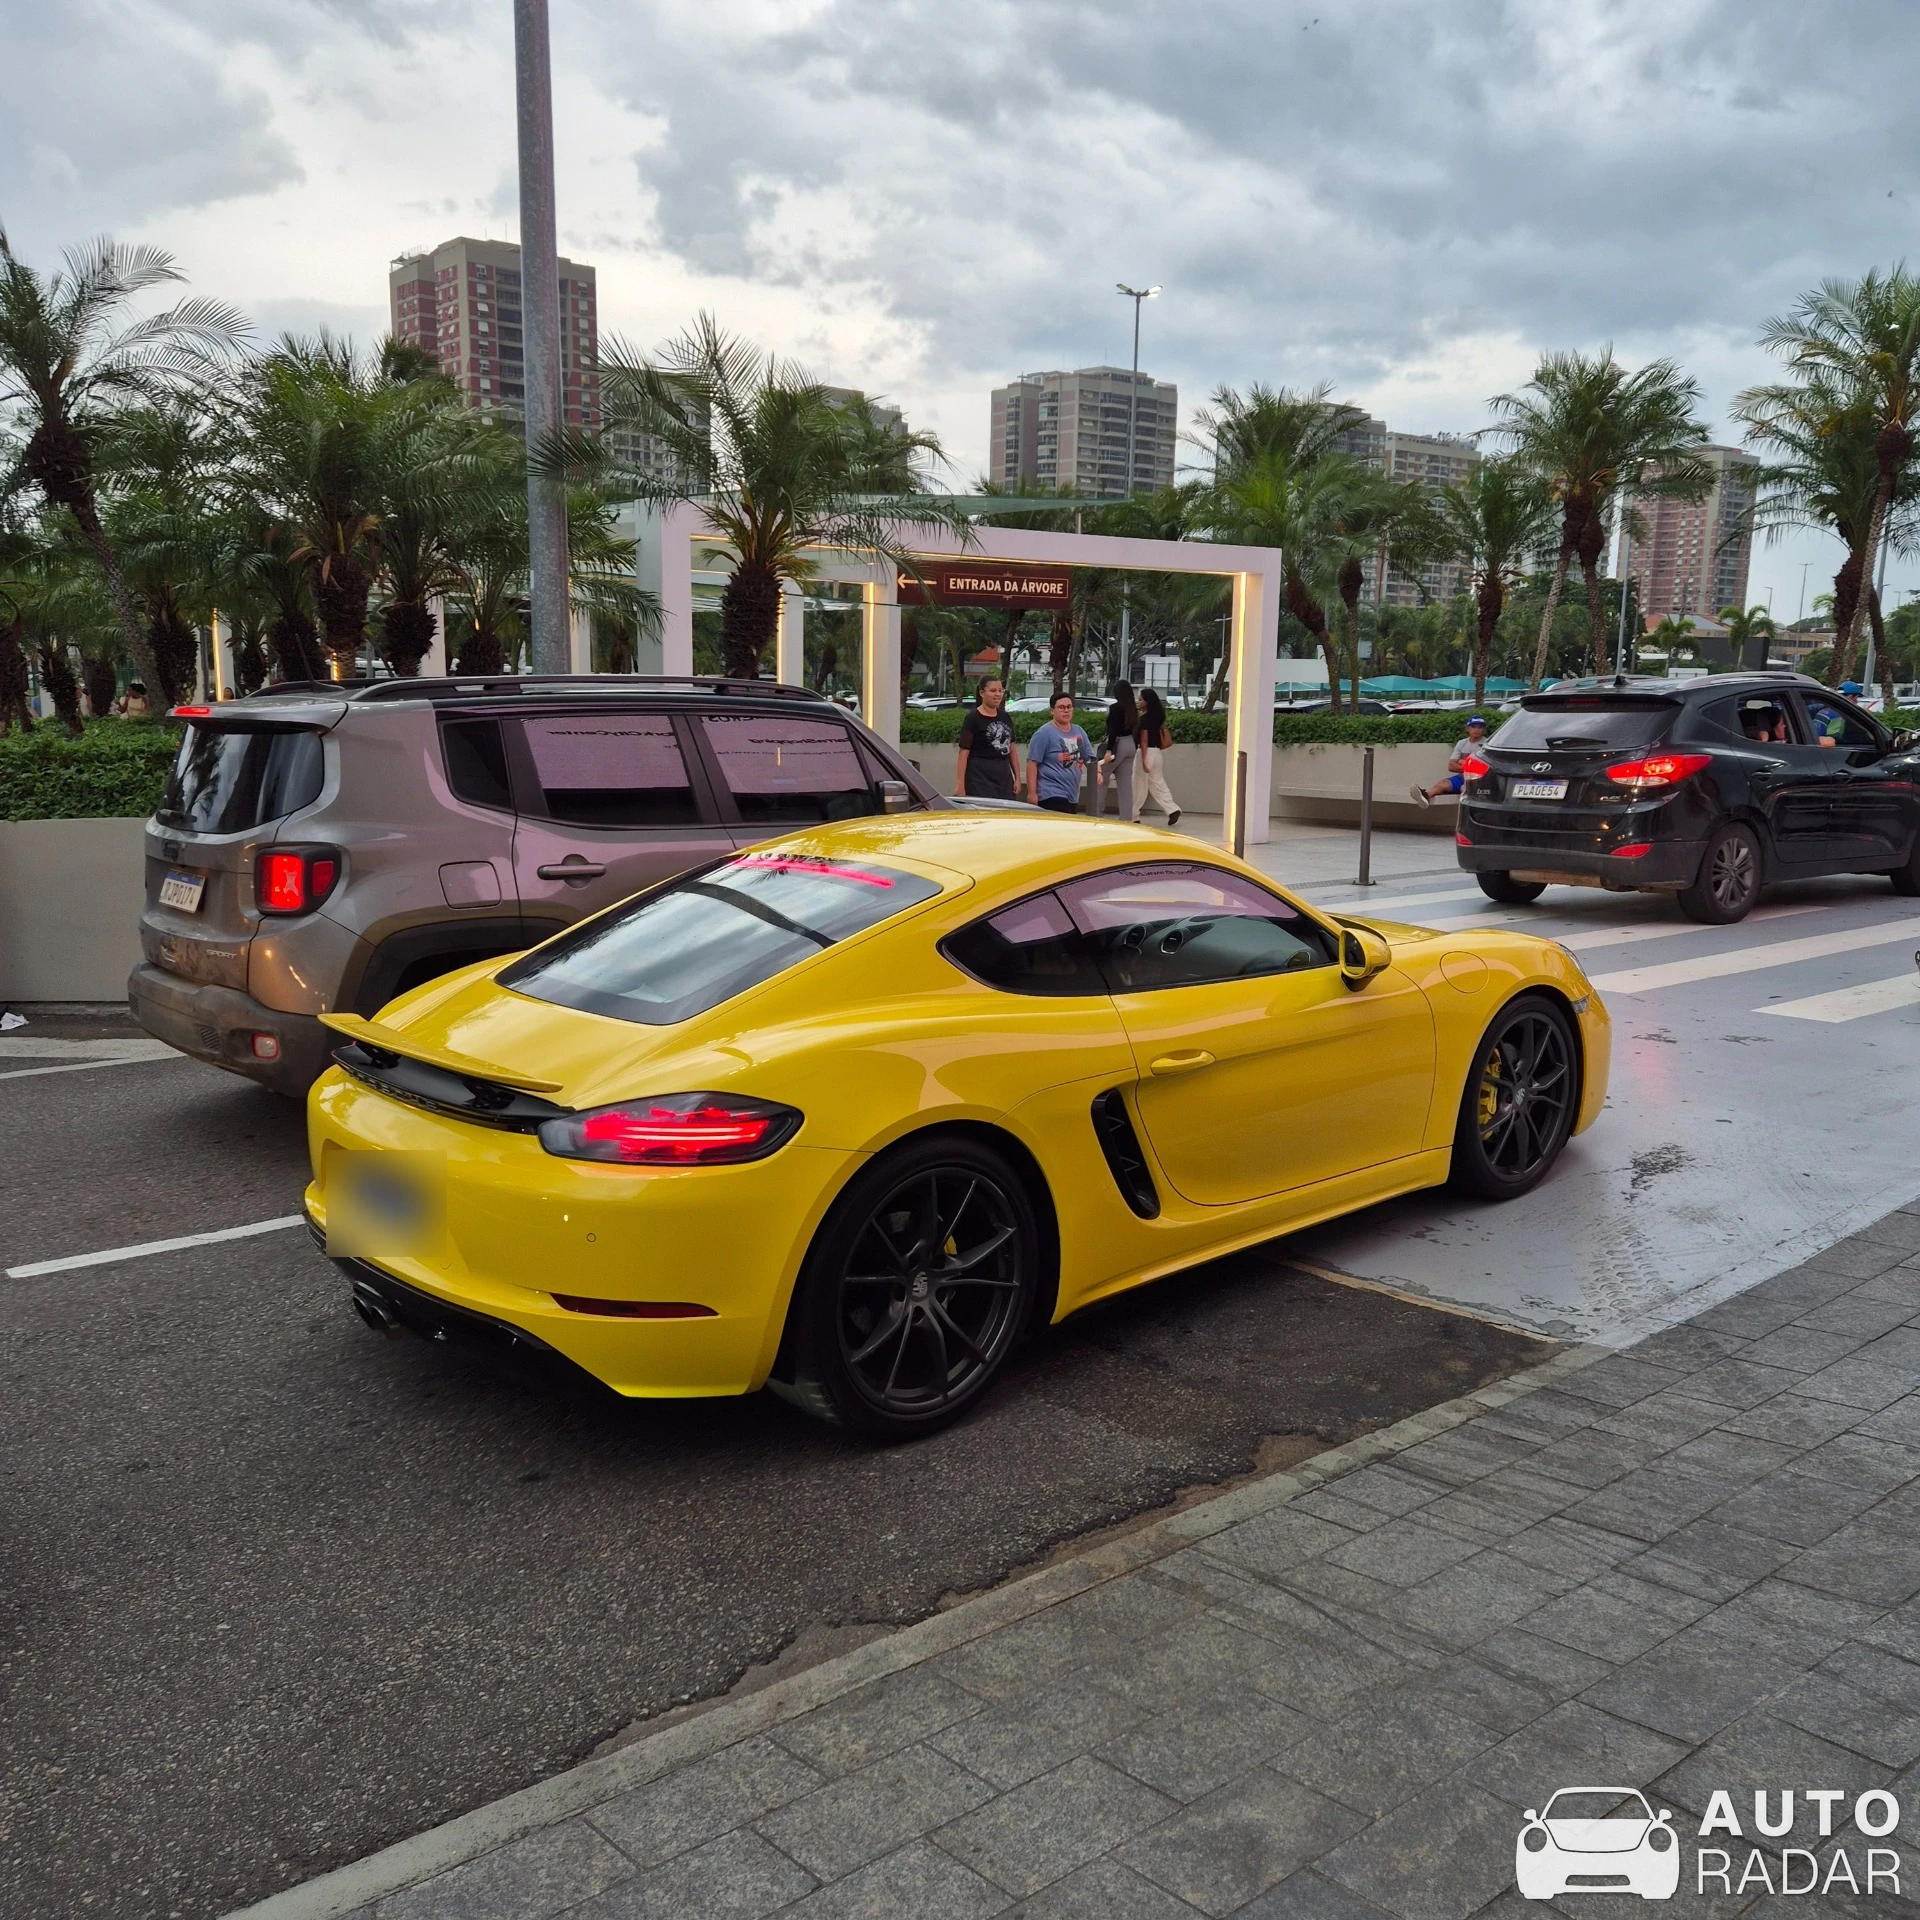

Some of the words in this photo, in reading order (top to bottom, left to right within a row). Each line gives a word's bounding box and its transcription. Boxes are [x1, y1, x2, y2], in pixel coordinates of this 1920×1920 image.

[949, 577, 1001, 592] ENTRADA
[1004, 580, 1018, 593] DA
[1021, 578, 1063, 594] ÁRVORE
[206, 949, 238, 959] SPORT
